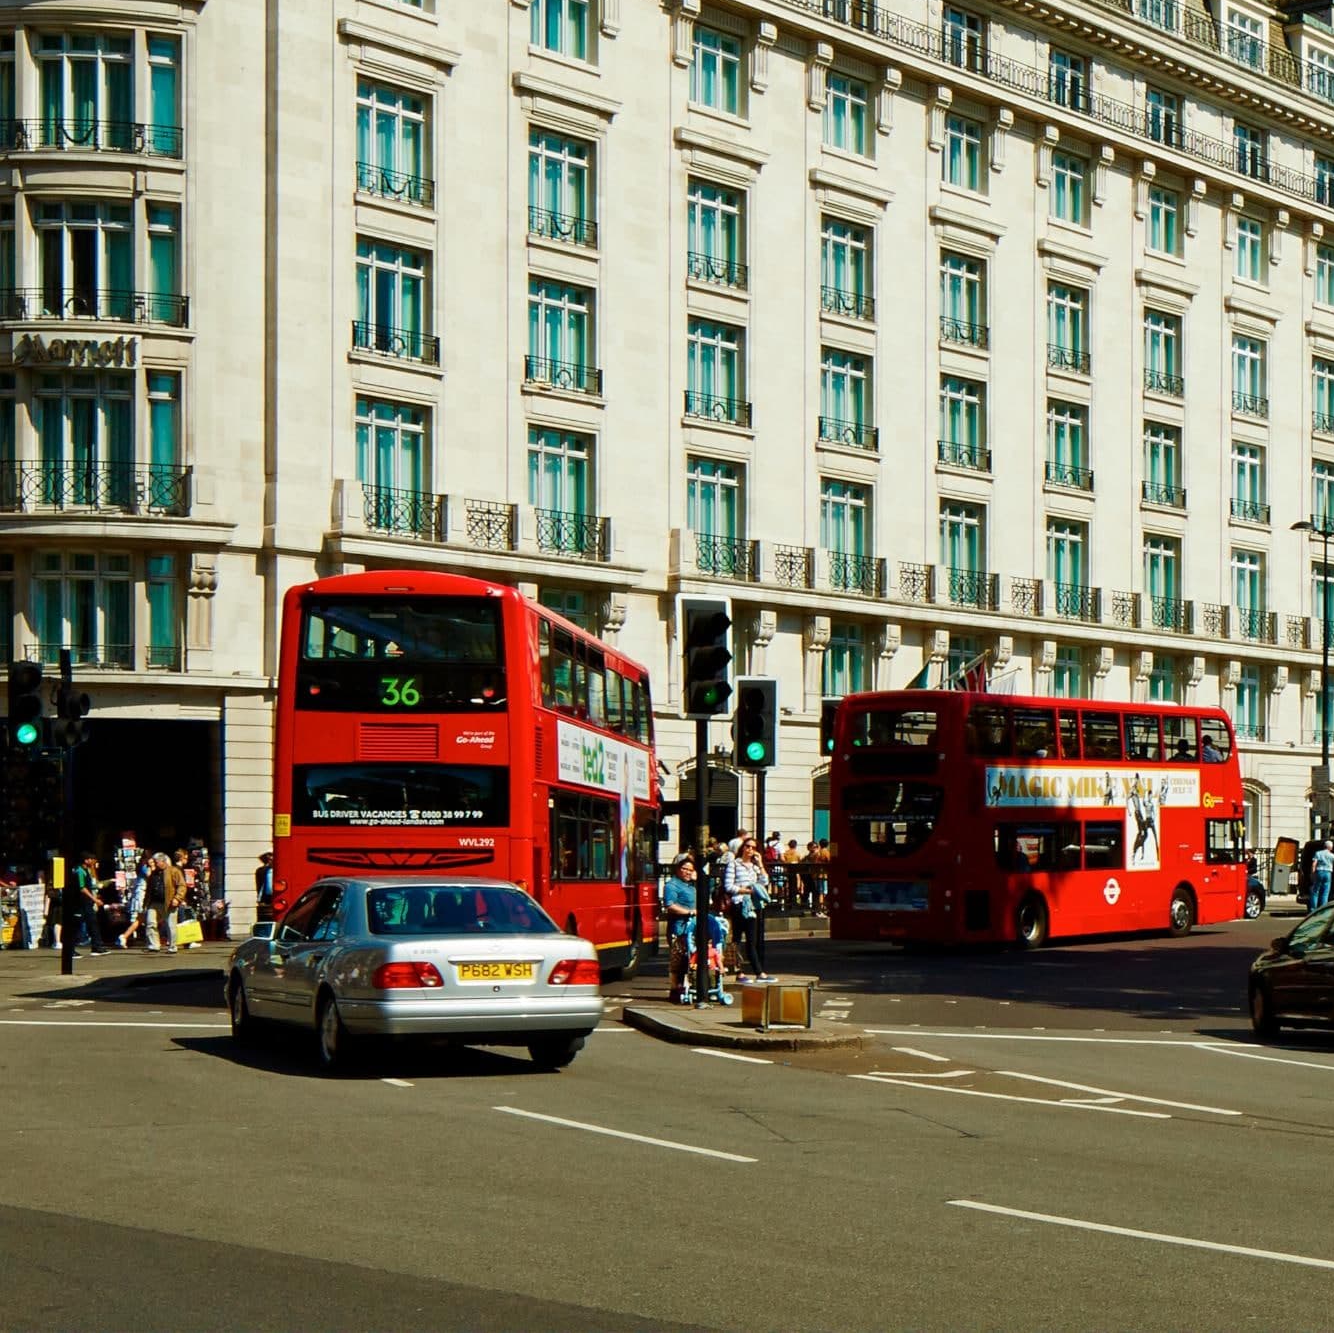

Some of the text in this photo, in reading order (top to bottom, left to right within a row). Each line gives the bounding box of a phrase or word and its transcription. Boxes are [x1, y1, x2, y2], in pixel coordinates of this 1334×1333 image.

[381, 678, 420, 706] 36
[999, 775, 1062, 798] MAGIC
[313, 810, 329, 818] BUS
[330, 810, 359, 818] DRIVER
[360, 810, 407, 819] VACANCIES
[421, 811, 441, 819] 0800
[454, 811, 464, 819] 99
[472, 811, 483, 819] 99
[459, 838, 495, 847] WVL292
[461, 963, 532, 977] P682 WSH
